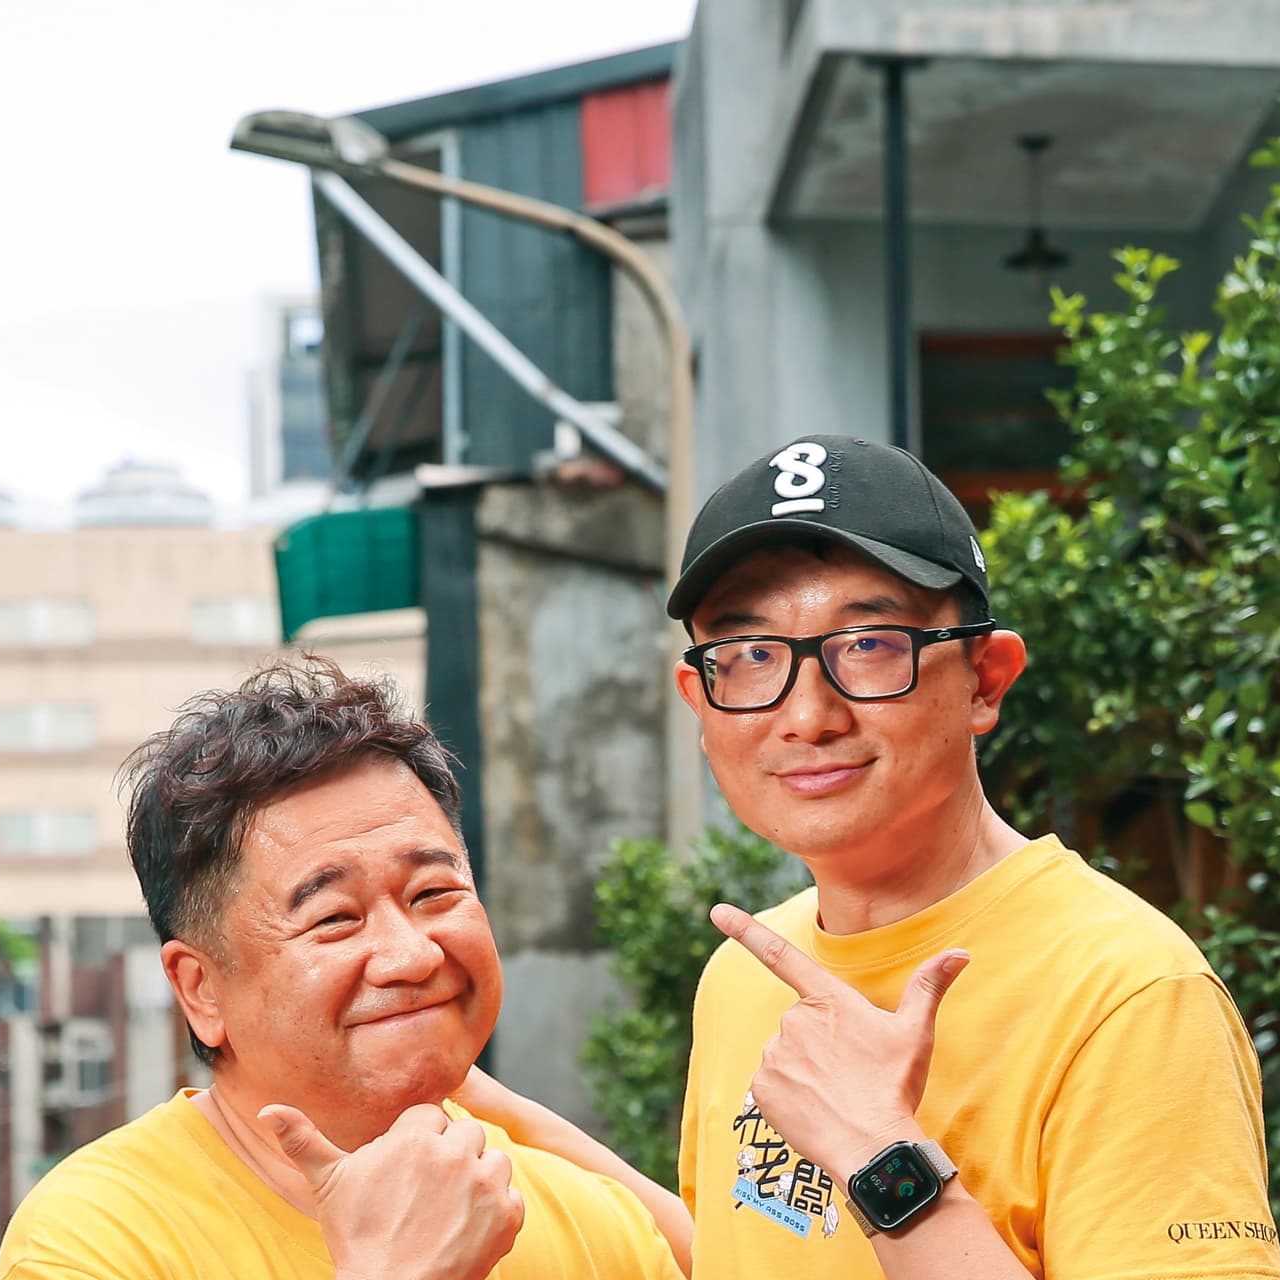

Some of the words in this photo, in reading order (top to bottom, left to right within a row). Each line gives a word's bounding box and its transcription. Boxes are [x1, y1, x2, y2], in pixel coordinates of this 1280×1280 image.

[765, 1206, 783, 1219] ASS
[783, 1215, 806, 1232] BOSS
[1167, 1221, 1241, 1244] QUEEN
